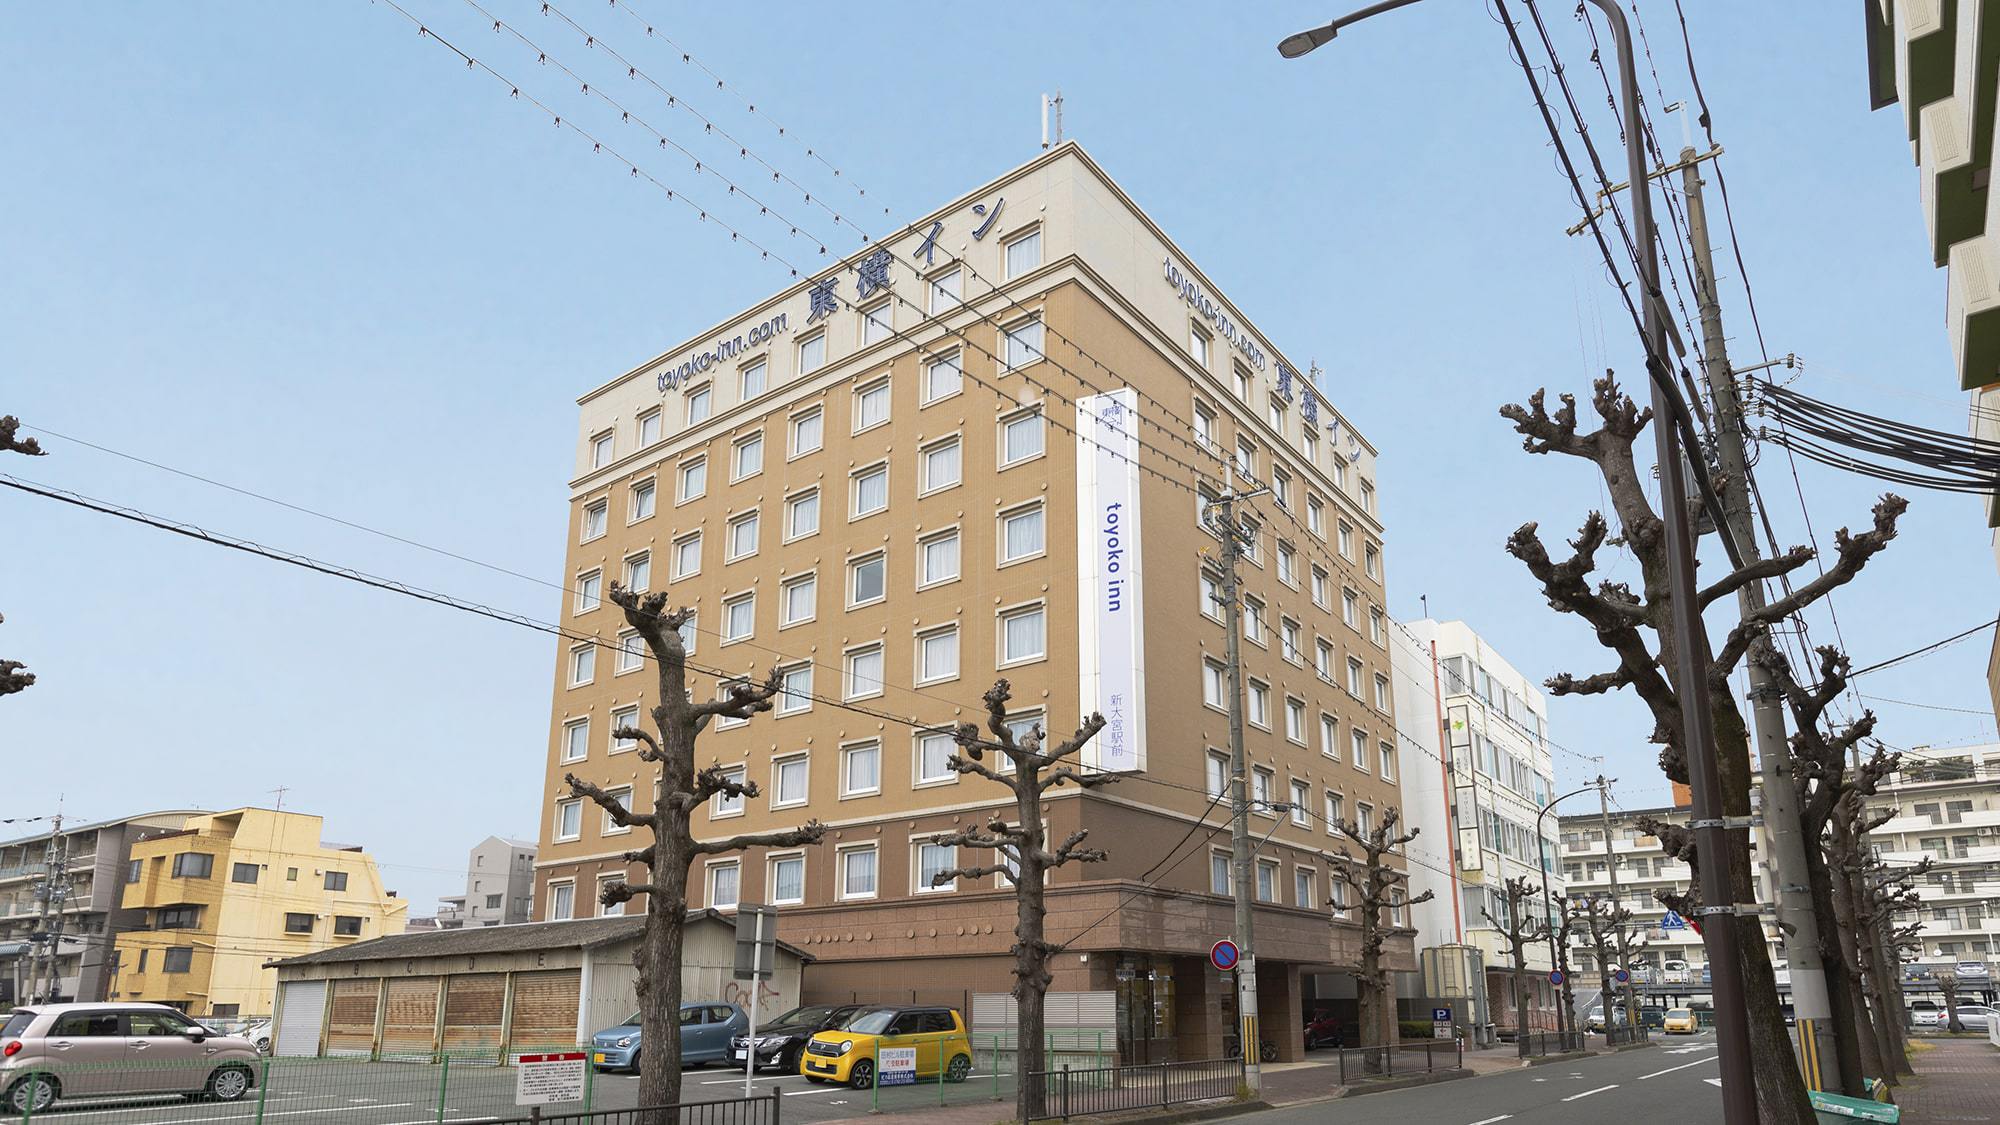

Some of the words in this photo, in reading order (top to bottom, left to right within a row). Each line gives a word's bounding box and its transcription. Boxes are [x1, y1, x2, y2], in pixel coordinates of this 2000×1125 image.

[806, 197, 1006, 325] 東横イン
[1163, 256, 1266, 371] toyoko-inn.com
[656, 311, 789, 393] toyoko-inn.com
[1273, 360, 1362, 462] 東横イン
[1103, 502, 1124, 573] toyoko
[1108, 579, 1125, 612] inn
[1110, 692, 1124, 757] 新大宮駅前
[1437, 1010, 1446, 1020] P
